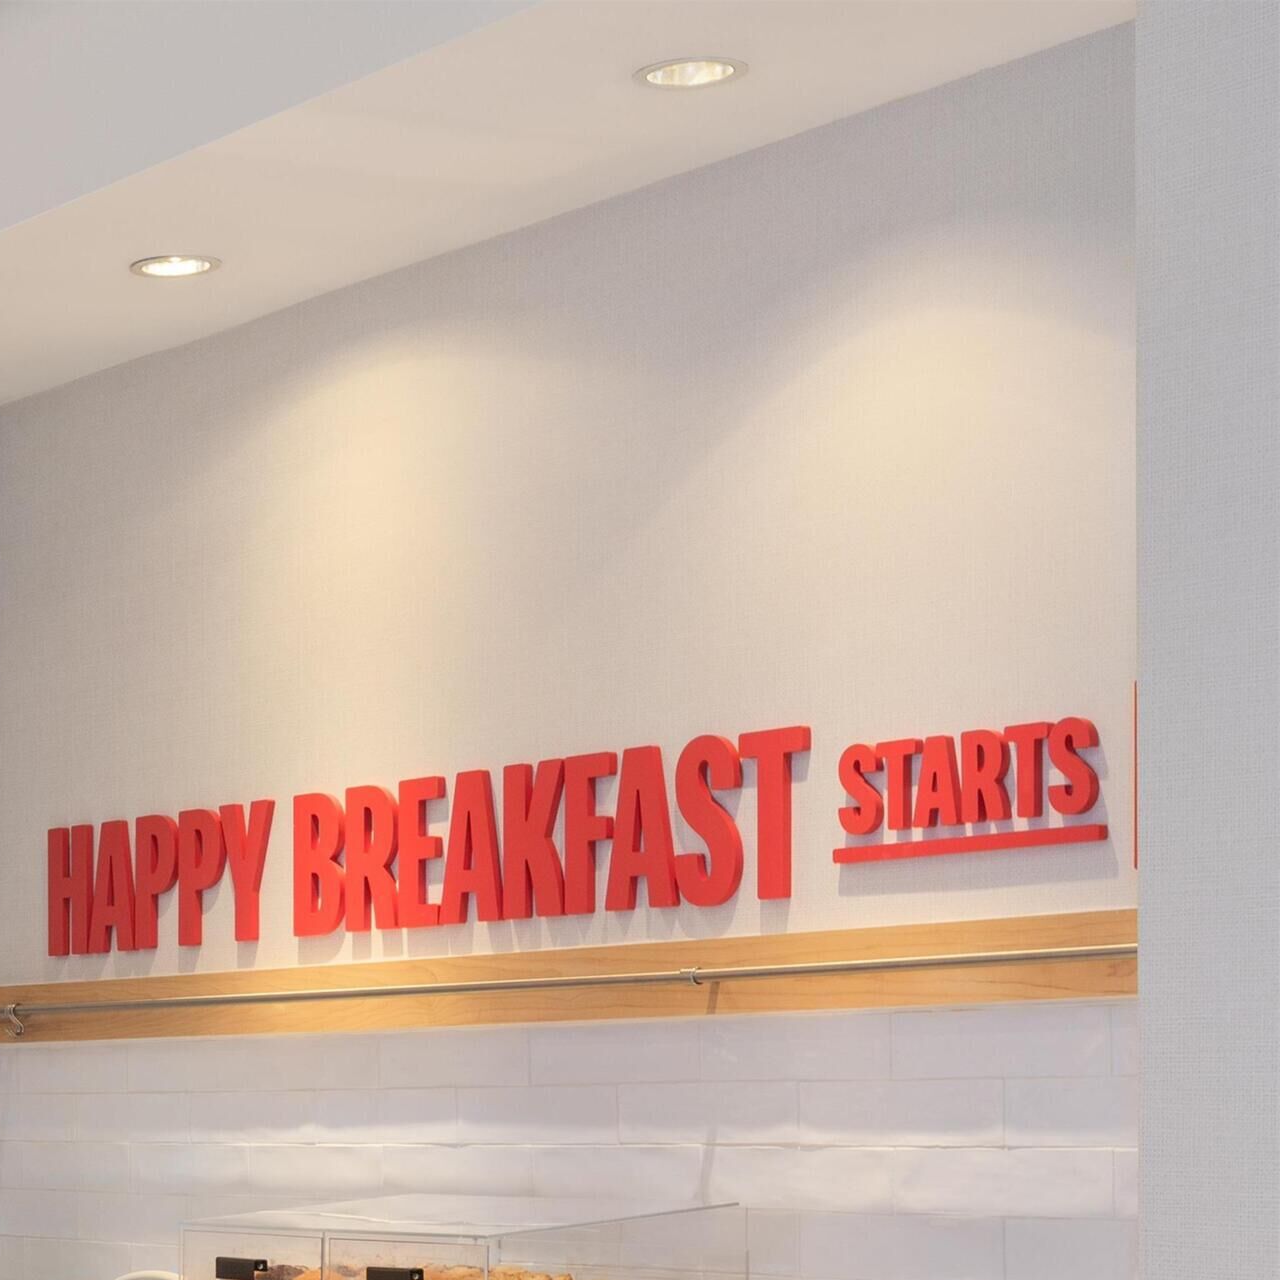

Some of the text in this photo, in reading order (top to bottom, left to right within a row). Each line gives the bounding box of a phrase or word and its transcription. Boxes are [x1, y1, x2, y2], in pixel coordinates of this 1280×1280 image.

[48, 716, 1100, 956] HAPPY BREAKFAST STARTS
